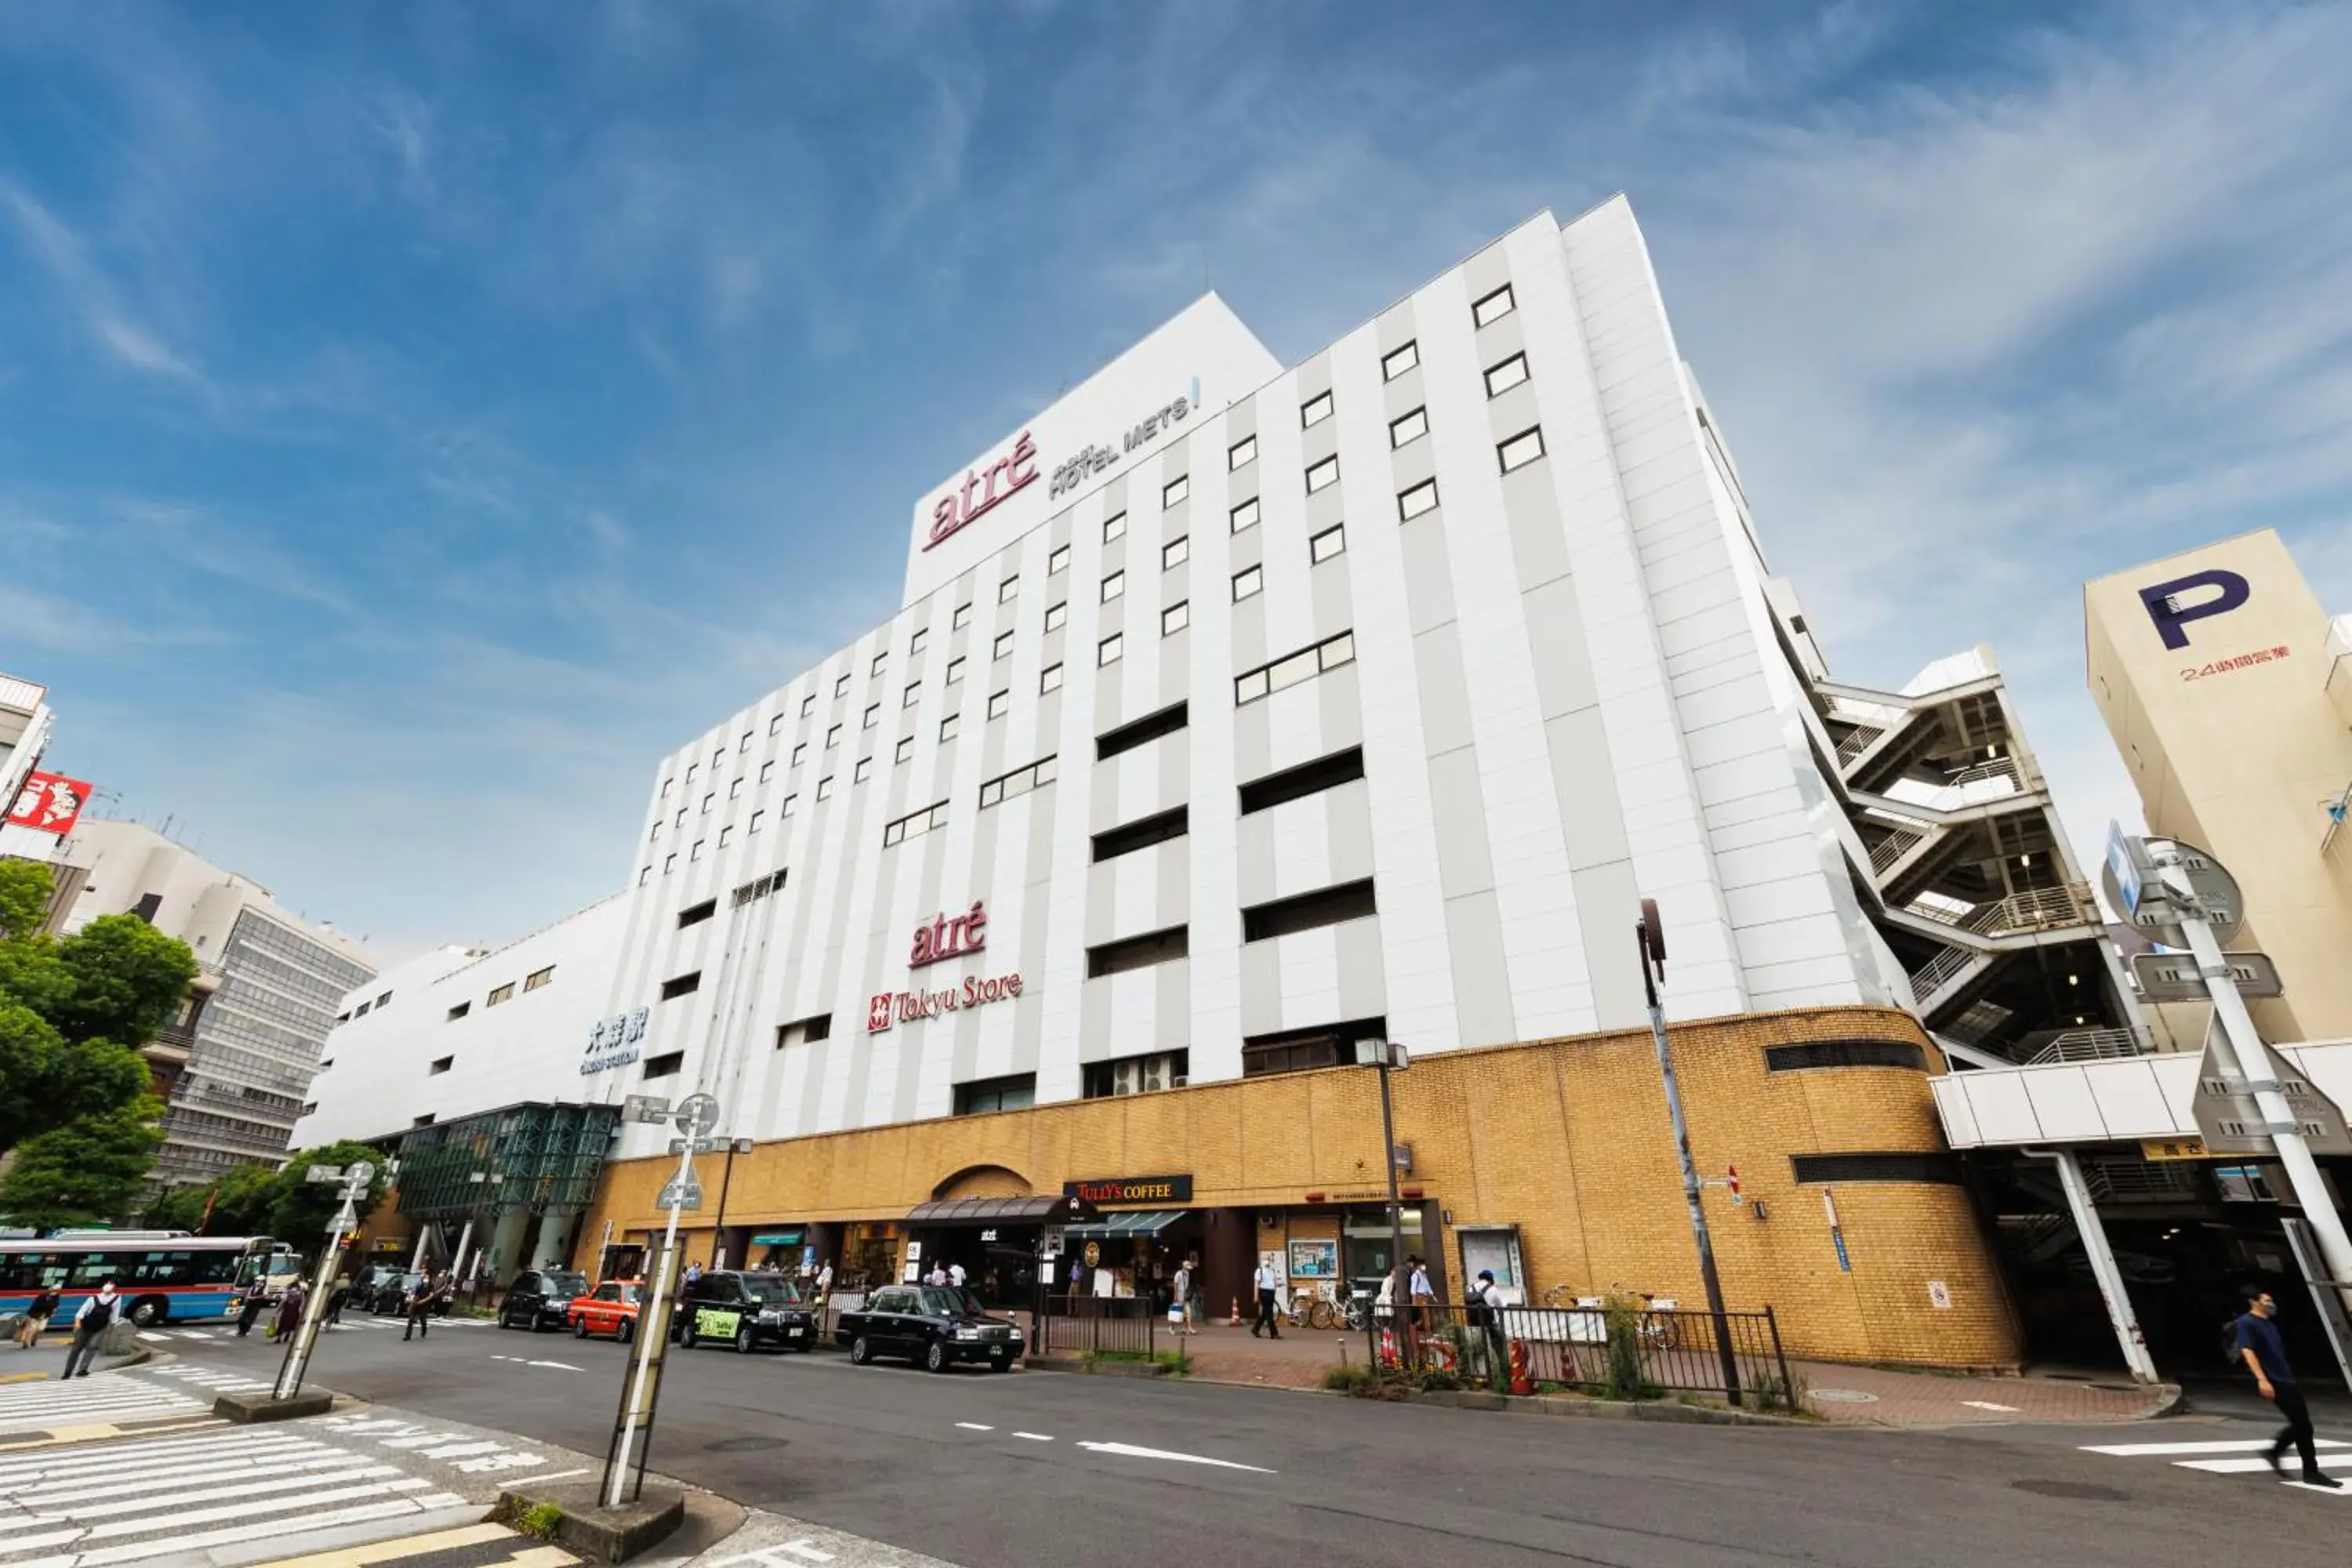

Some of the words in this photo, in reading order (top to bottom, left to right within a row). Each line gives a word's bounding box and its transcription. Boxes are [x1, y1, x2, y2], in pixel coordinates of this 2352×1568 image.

[1048, 444, 1120, 501] HOTEL
[1123, 395, 1189, 453] METS
[925, 428, 1041, 546] atré
[2138, 569, 2250, 650] P
[2180, 645, 2291, 683] 24時間営業
[908, 900, 987, 970] atré
[895, 987, 959, 1023] Tokyu
[961, 972, 1023, 1007] Store
[1078, 1183, 1122, 1200] TULLY'S
[1123, 1184, 1171, 1199] COFFEE
